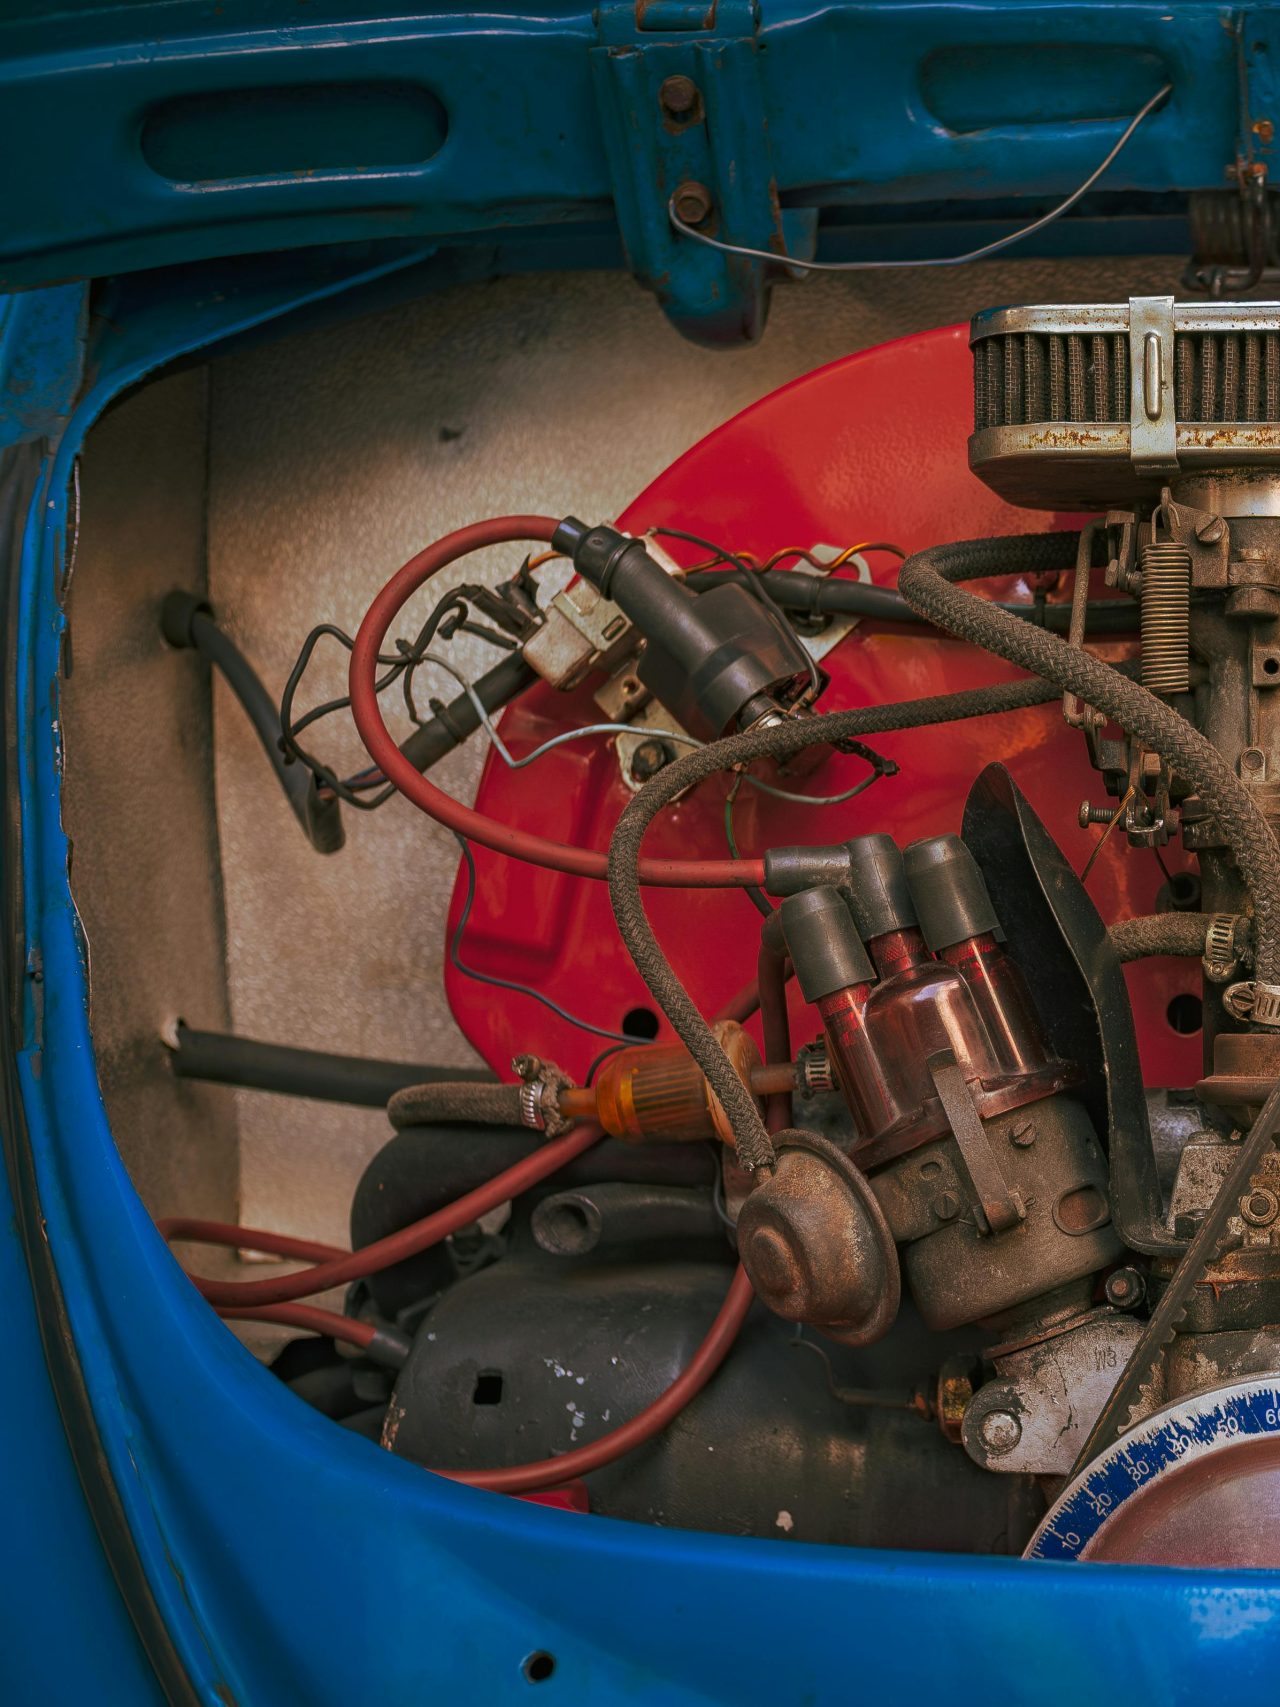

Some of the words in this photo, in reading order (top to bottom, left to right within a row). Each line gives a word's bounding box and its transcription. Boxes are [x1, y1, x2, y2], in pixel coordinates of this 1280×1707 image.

[1061, 1531, 1081, 1550] 10
[1089, 1492, 1112, 1516] 20
[1127, 1460, 1150, 1481] 30
[1170, 1434, 1191, 1453] 40
[1216, 1416, 1239, 1434] 50
